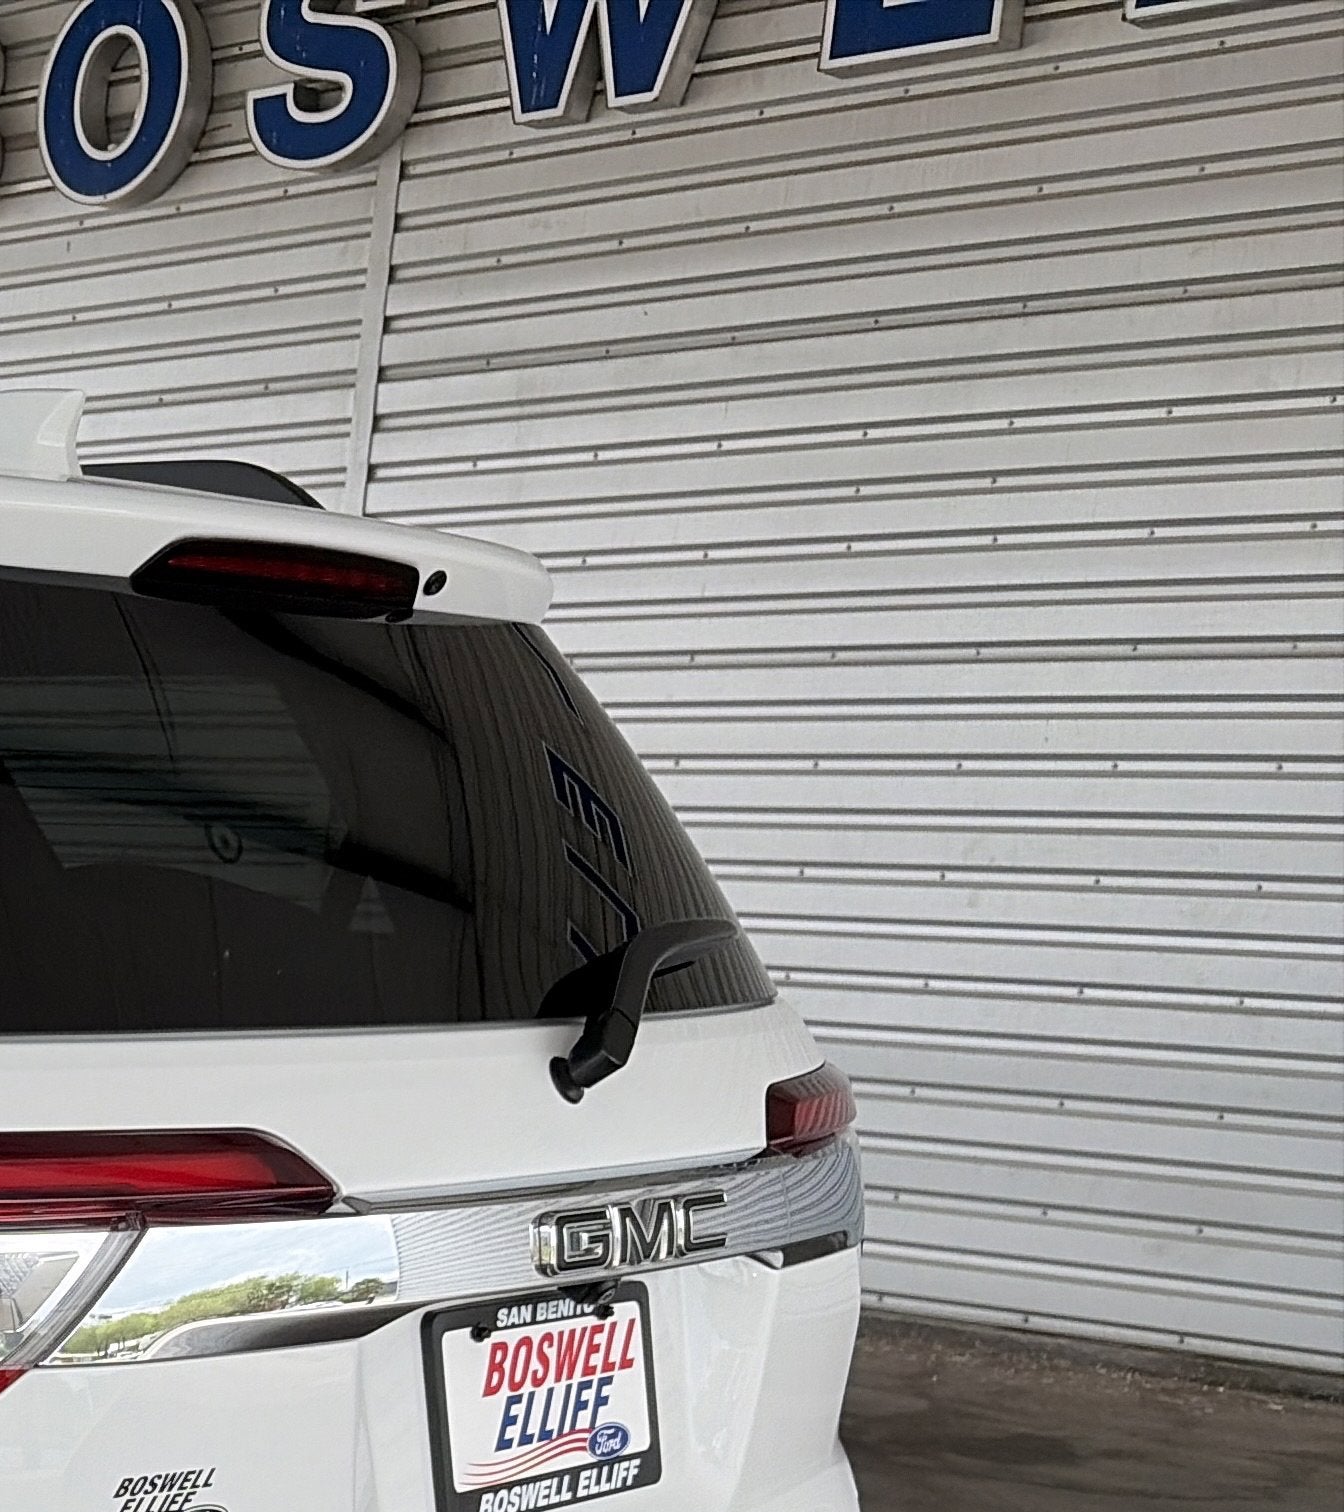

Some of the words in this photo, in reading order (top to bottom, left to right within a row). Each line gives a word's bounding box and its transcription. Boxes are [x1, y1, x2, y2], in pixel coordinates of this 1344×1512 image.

[529, 1188, 728, 1278] GMC
[496, 1303, 534, 1328] SAN
[482, 1317, 637, 1398] BOSWELL
[494, 1375, 616, 1453] ELLIFF
[594, 1428, 623, 1456] Ford
[113, 1467, 217, 1499] BOSWELL
[576, 1458, 642, 1498] ELLIFF
